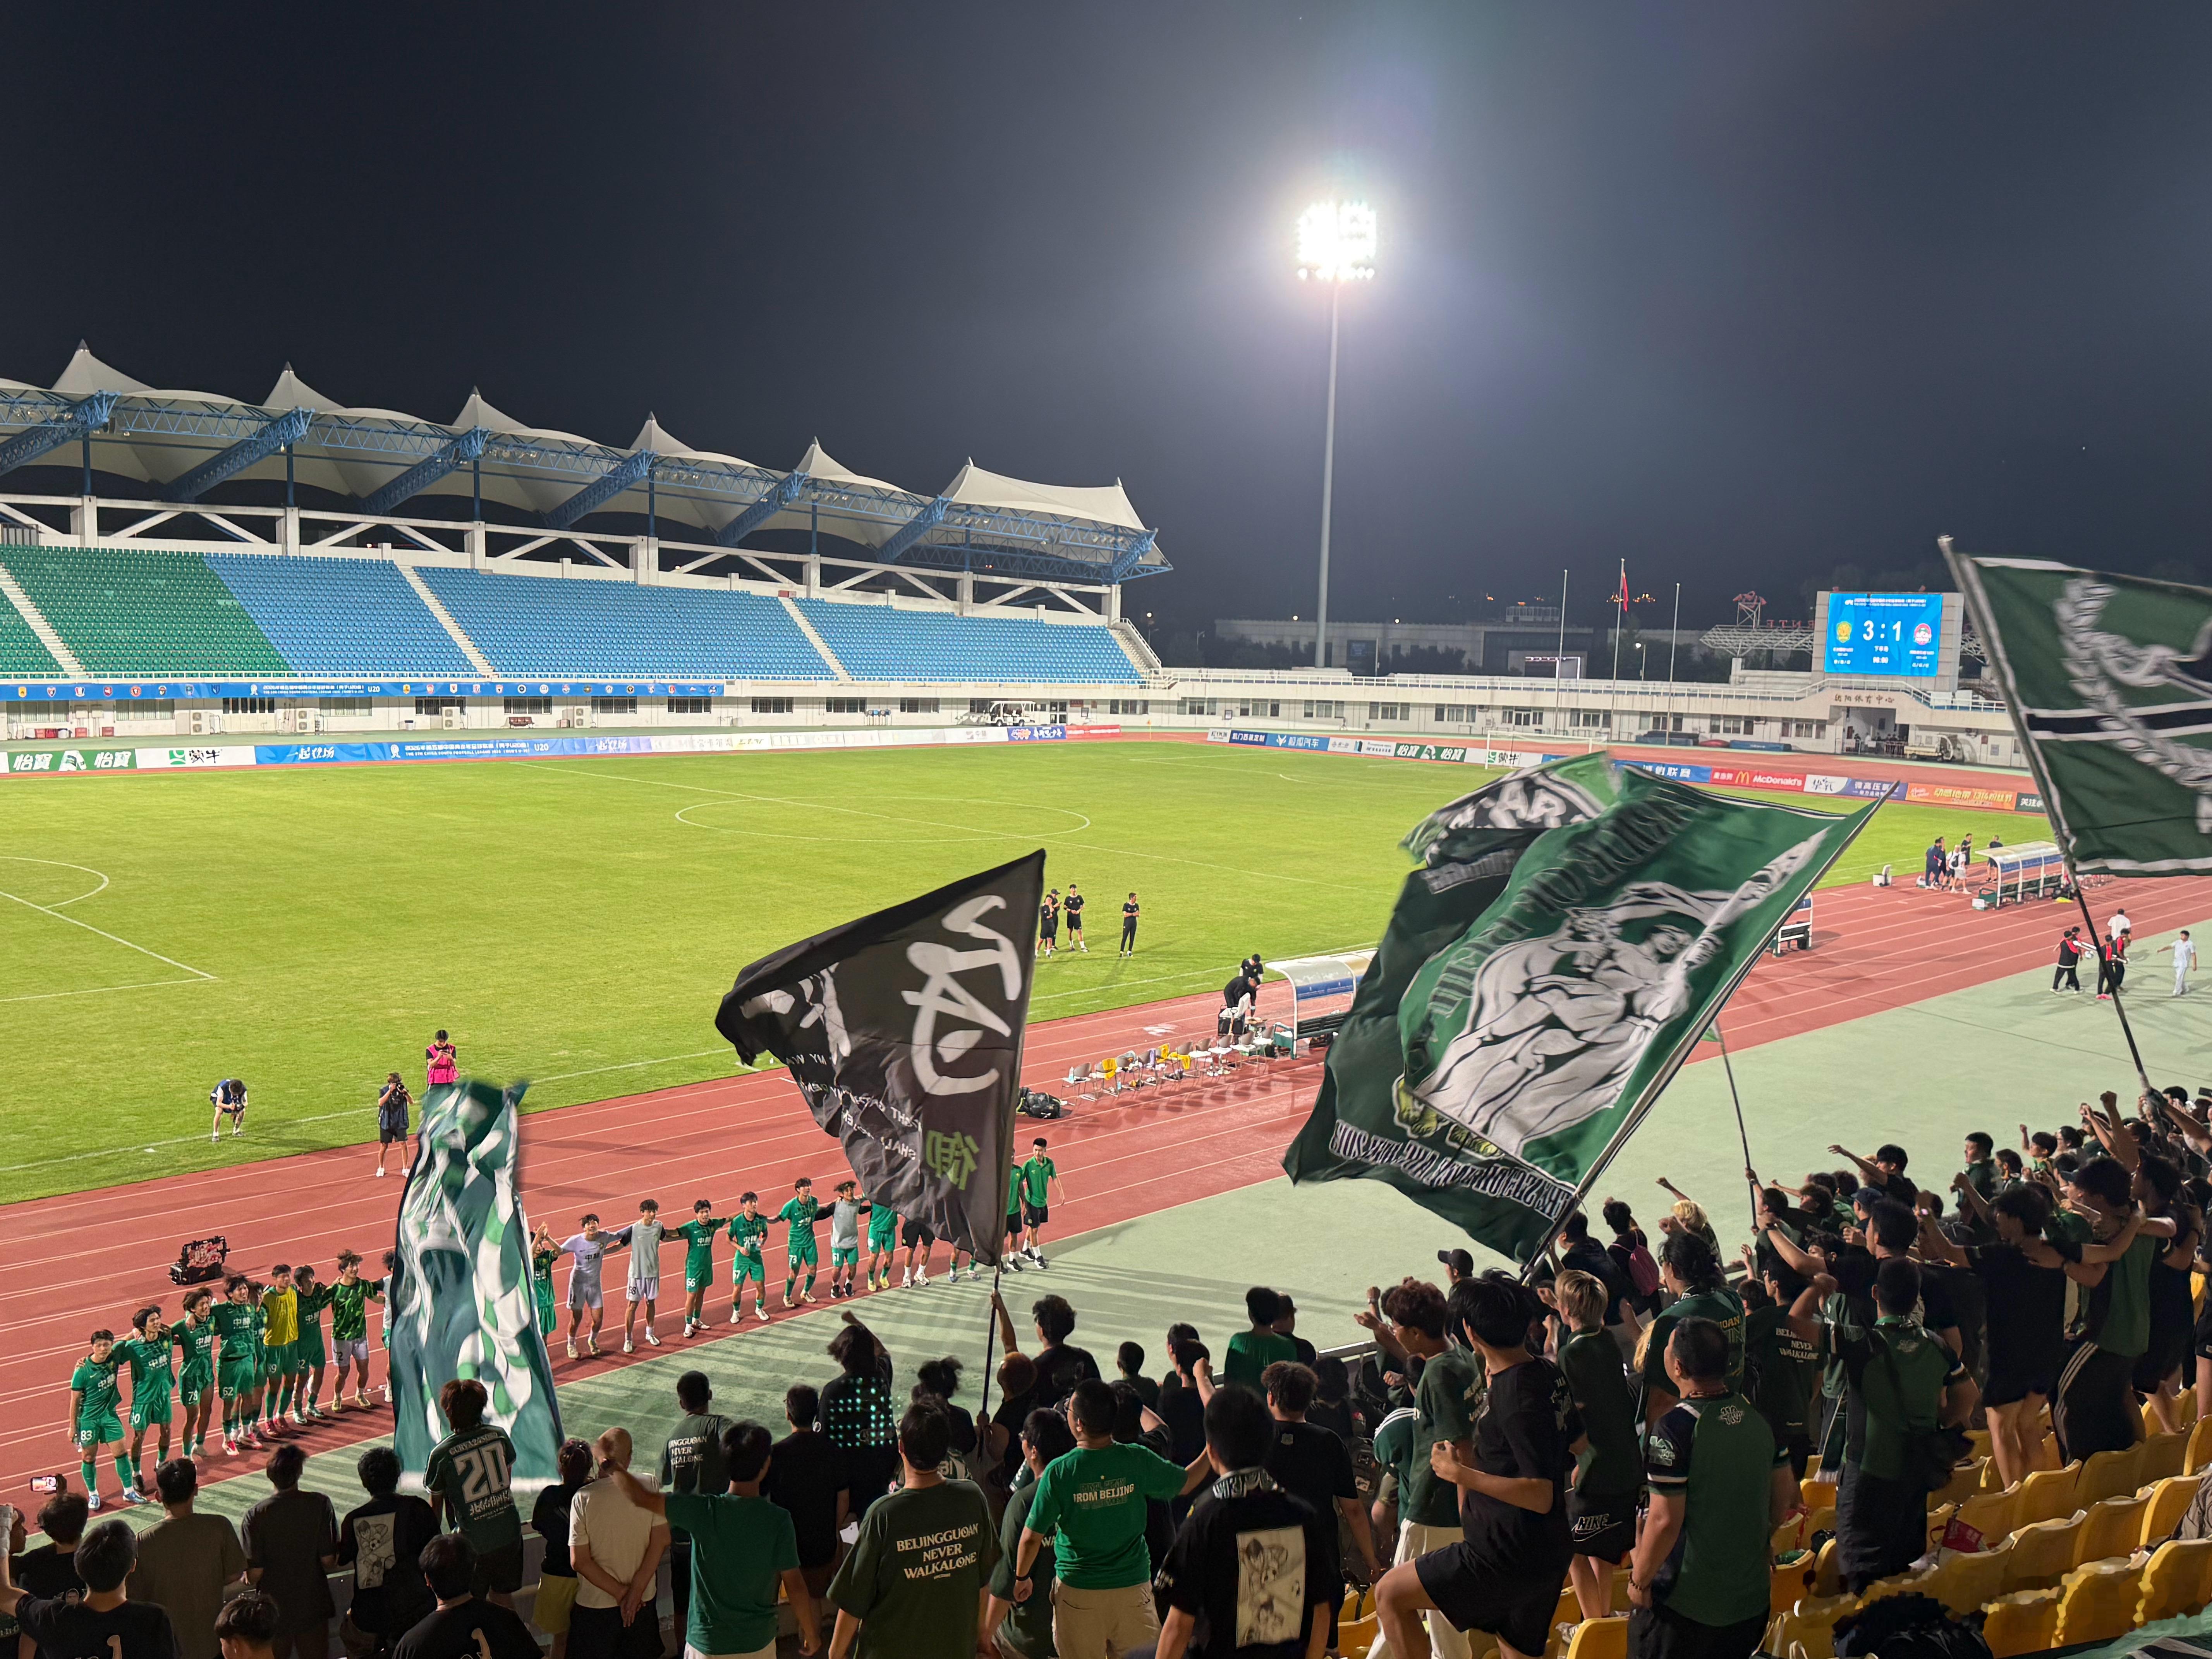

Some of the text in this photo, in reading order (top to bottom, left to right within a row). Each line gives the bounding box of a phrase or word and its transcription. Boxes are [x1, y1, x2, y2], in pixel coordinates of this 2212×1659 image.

[1863, 620, 1874, 641] 3
[1893, 620, 1901, 641] 1
[534, 743, 549, 751] U20
[1753, 774, 1802, 787] McDonald's
[188, 1390, 198, 1400] 78
[223, 1386, 234, 1396] 62
[80, 1430, 93, 1441] 83
[452, 1439, 510, 1504] 20
[1099, 1483, 1134, 1499] BEIJING
[1575, 1513, 1609, 1530] NIKE
[896, 1523, 979, 1552] BEIJINGGUOAN
[923, 1543, 962, 1562] NEVER
[903, 1551, 977, 1580] WALKALONE
